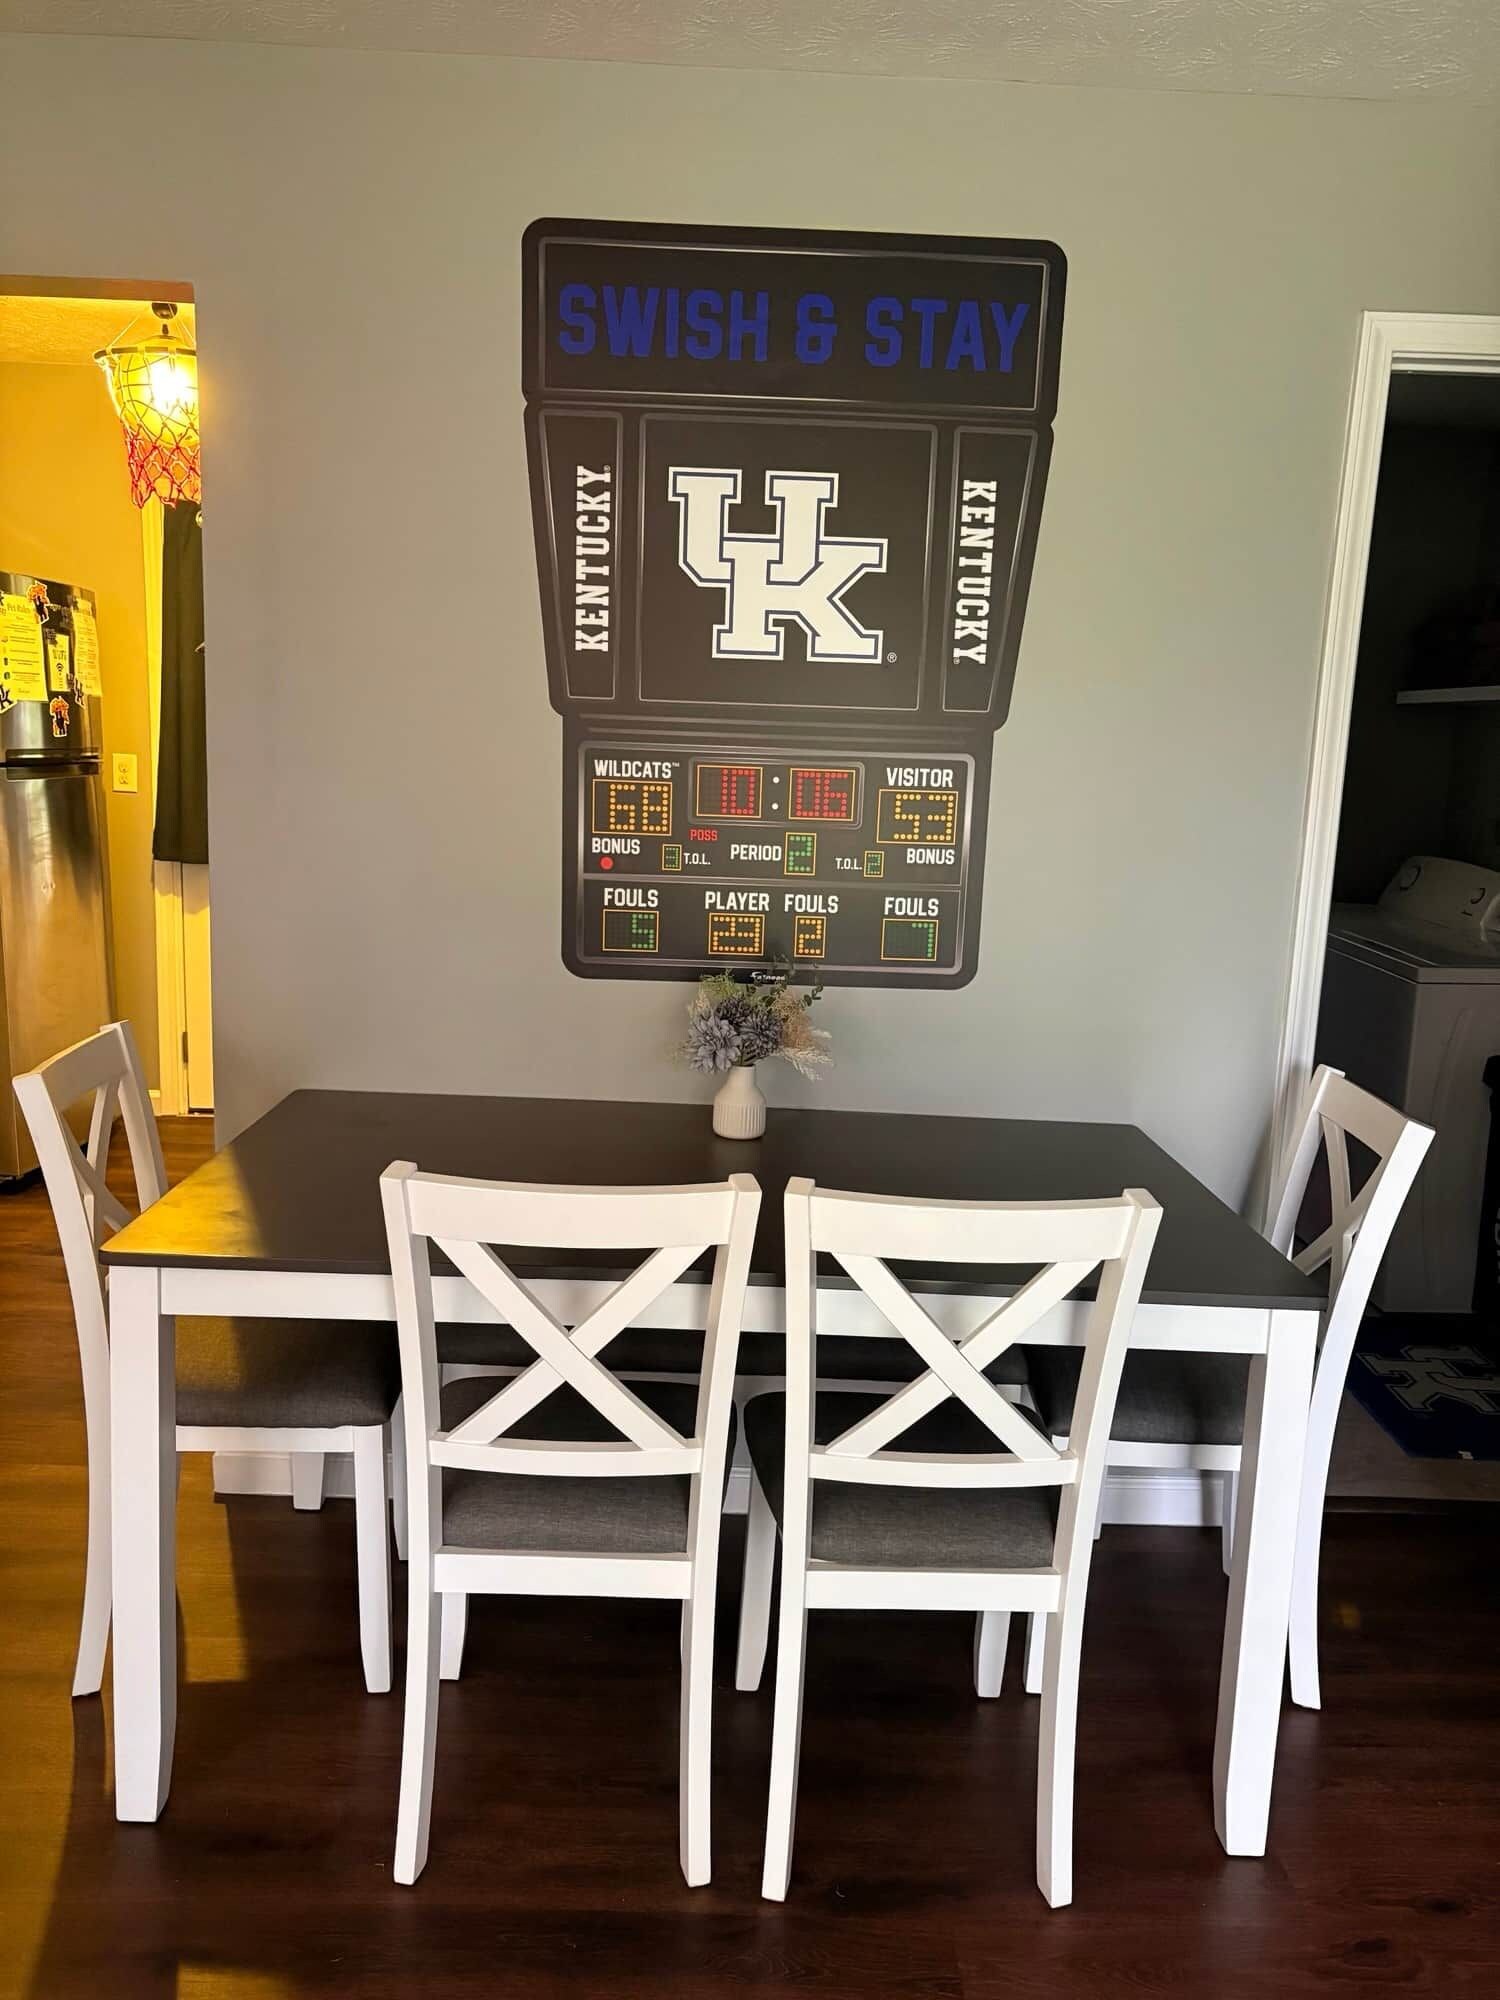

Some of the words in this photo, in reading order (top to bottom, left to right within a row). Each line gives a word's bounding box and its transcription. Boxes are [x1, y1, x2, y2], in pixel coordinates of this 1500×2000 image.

[558, 283, 769, 363] SWISH
[794, 293, 838, 365] &
[864, 296, 1031, 373] STAY
[574, 465, 612, 653] KENTUCKY
[668, 466, 889, 665] UK
[953, 479, 997, 666] KENTUCKY
[886, 767, 954, 788] VISITOR
[609, 783, 669, 832] 68
[893, 793, 955, 842] 53
[592, 837, 641, 855] BONUS
[690, 829, 718, 841] POSS
[684, 853, 711, 865] T.O.L.
[730, 844, 782, 862] PERIOD
[788, 835, 813, 872] 2
[835, 857, 863, 870] T.O.L.
[906, 848, 955, 865] BONUS
[603, 887, 659, 908] FOULS
[704, 891, 770, 912] PLAYER
[784, 893, 839, 914] FOULS
[884, 896, 940, 917] FOULS
[631, 913, 655, 949] 5
[798, 919, 822, 954] 2
[911, 922, 935, 958] 7
